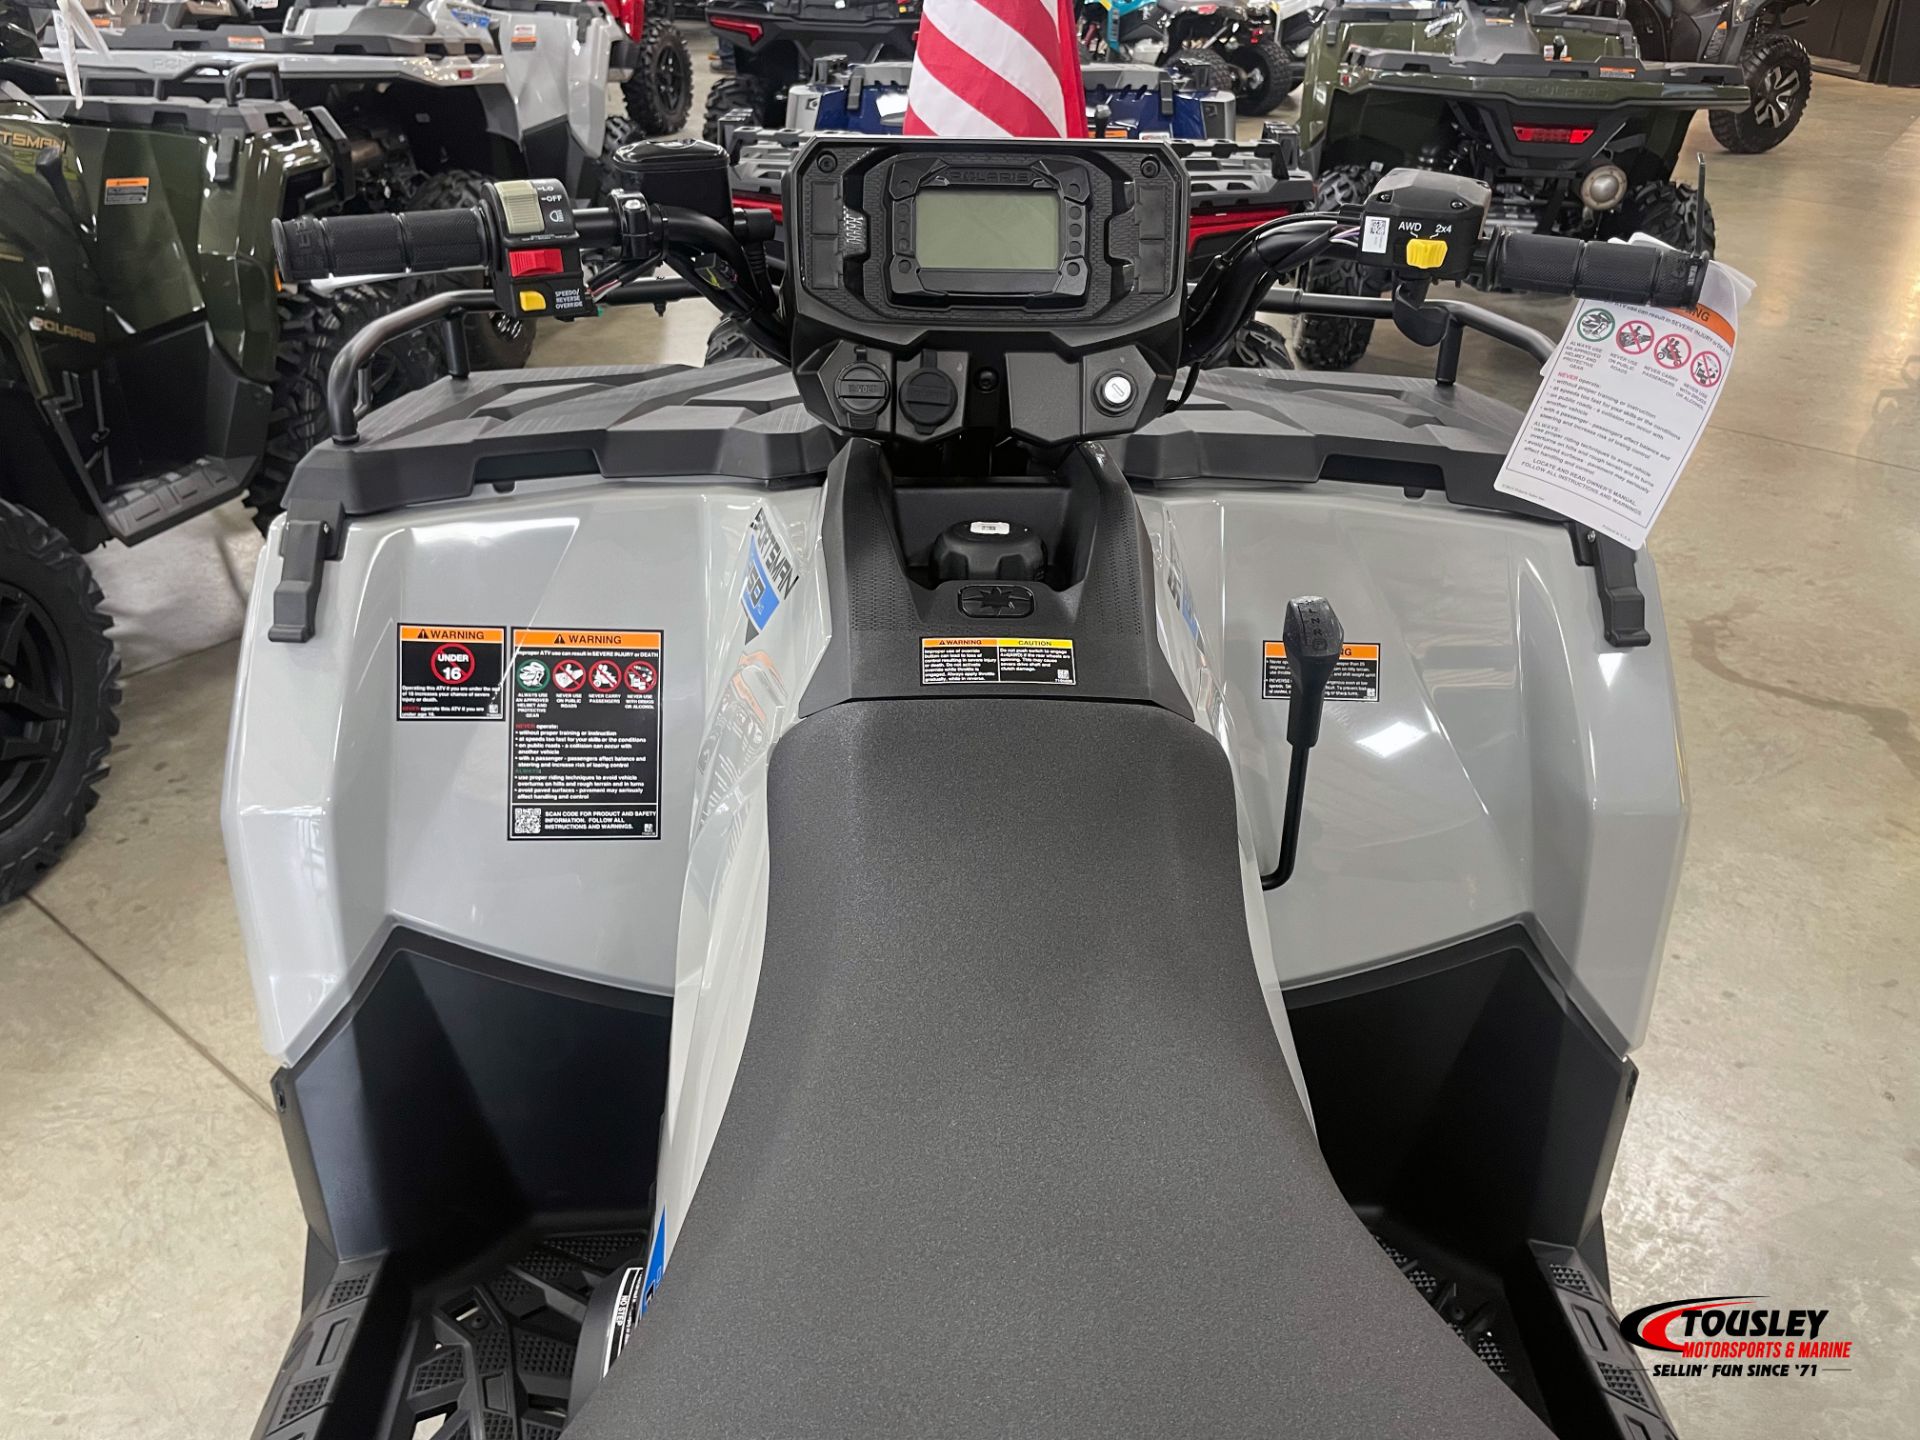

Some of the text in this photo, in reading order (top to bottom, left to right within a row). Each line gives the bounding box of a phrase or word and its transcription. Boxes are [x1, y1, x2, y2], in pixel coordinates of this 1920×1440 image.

[1398, 221, 1452, 233] AWD 2x4
[555, 288, 580, 297] SPEEDO/
[555, 301, 583, 309] OVERRIDE
[556, 295, 581, 303] REVERSE
[1557, 370, 1578, 382] NEVER
[1555, 377, 1578, 389] without
[1577, 384, 1596, 396] proper
[1532, 457, 1555, 470] LOCATE
[1556, 466, 1569, 475] AND
[1569, 471, 1586, 482] READ
[1520, 460, 1545, 473] FOLLOW
[1545, 469, 1558, 477] ALL
[1557, 473, 1599, 495] INSTRUCTIONS
[1598, 490, 1612, 500] AND
[430, 630, 484, 640] WARNING
[569, 635, 622, 644] WARNING
[437, 654, 469, 663] UNDER
[443, 667, 461, 680] 16
[616, 1295, 629, 1326] NO STEP
